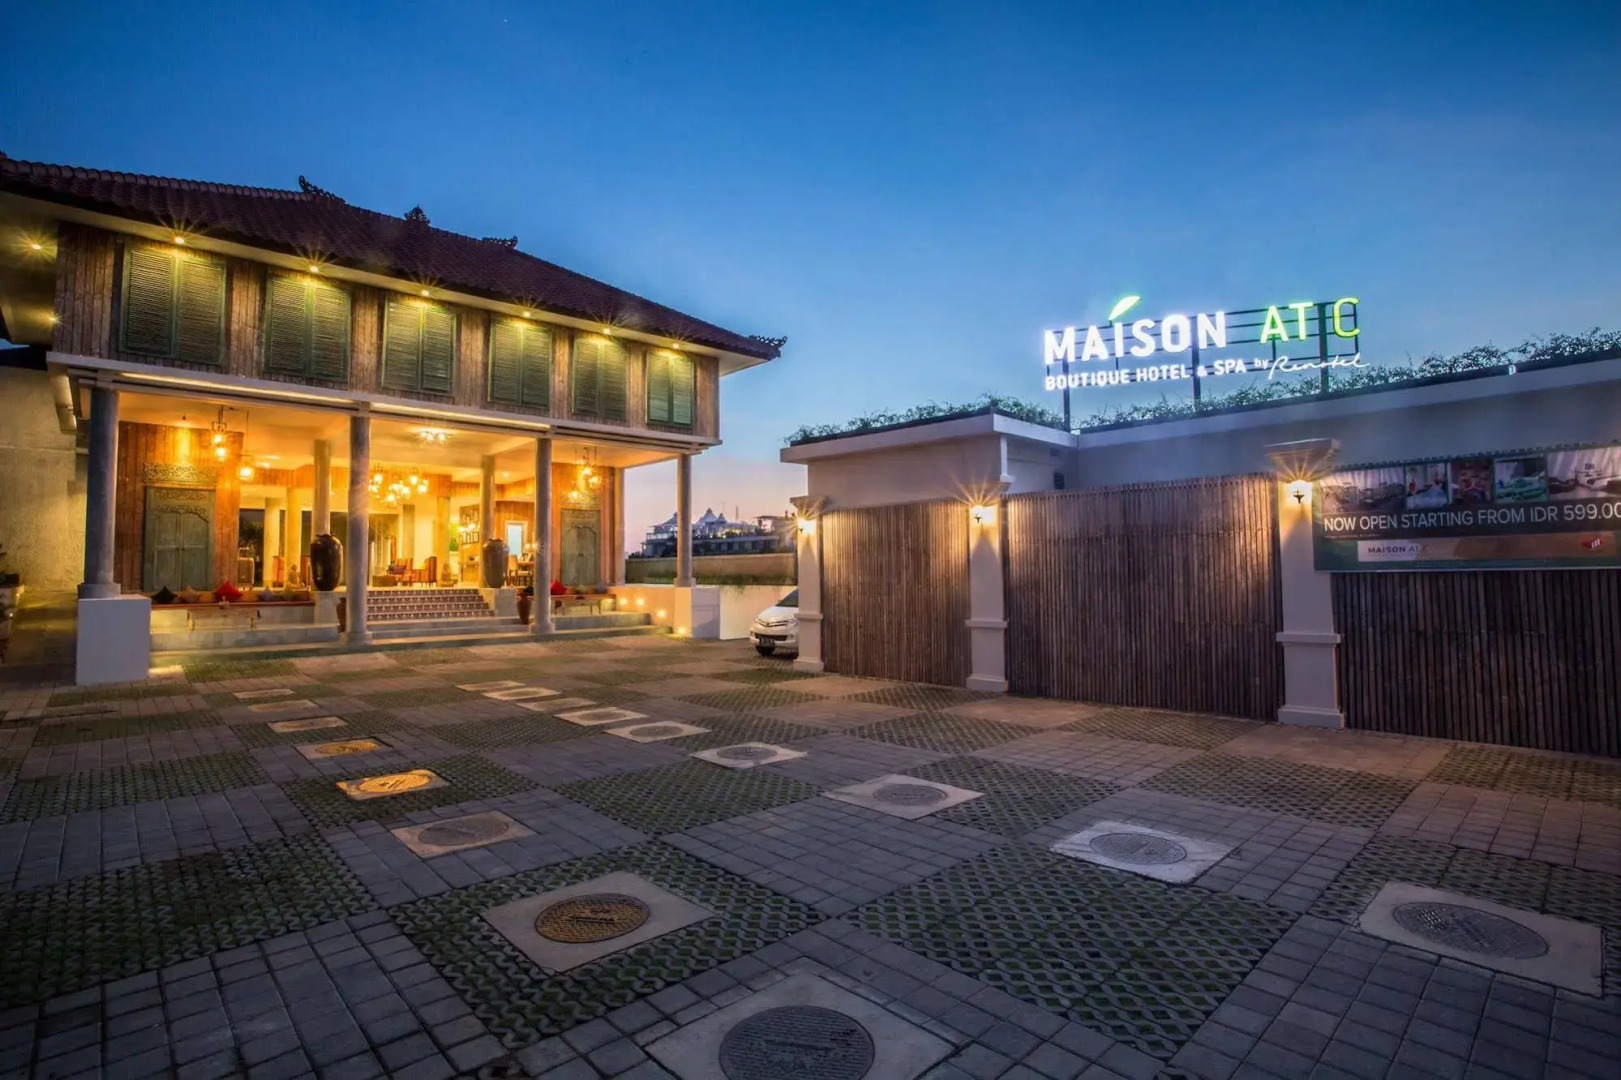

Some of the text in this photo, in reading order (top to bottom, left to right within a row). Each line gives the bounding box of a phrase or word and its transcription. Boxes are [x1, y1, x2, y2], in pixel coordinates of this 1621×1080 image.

[1044, 297, 1361, 365] MAISON AT C
[1045, 368, 1130, 391] BOUTIQUE
[1136, 364, 1190, 383] HOTEL
[1196, 365, 1208, 377] &
[1213, 359, 1247, 376] SPA
[1254, 358, 1268, 370] by
[1324, 516, 1356, 531] NOW
[1359, 515, 1397, 530] OPEN
[1401, 510, 1473, 528] STARTING
[1478, 508, 1525, 525] FROM
[1530, 506, 1558, 522] IDR
